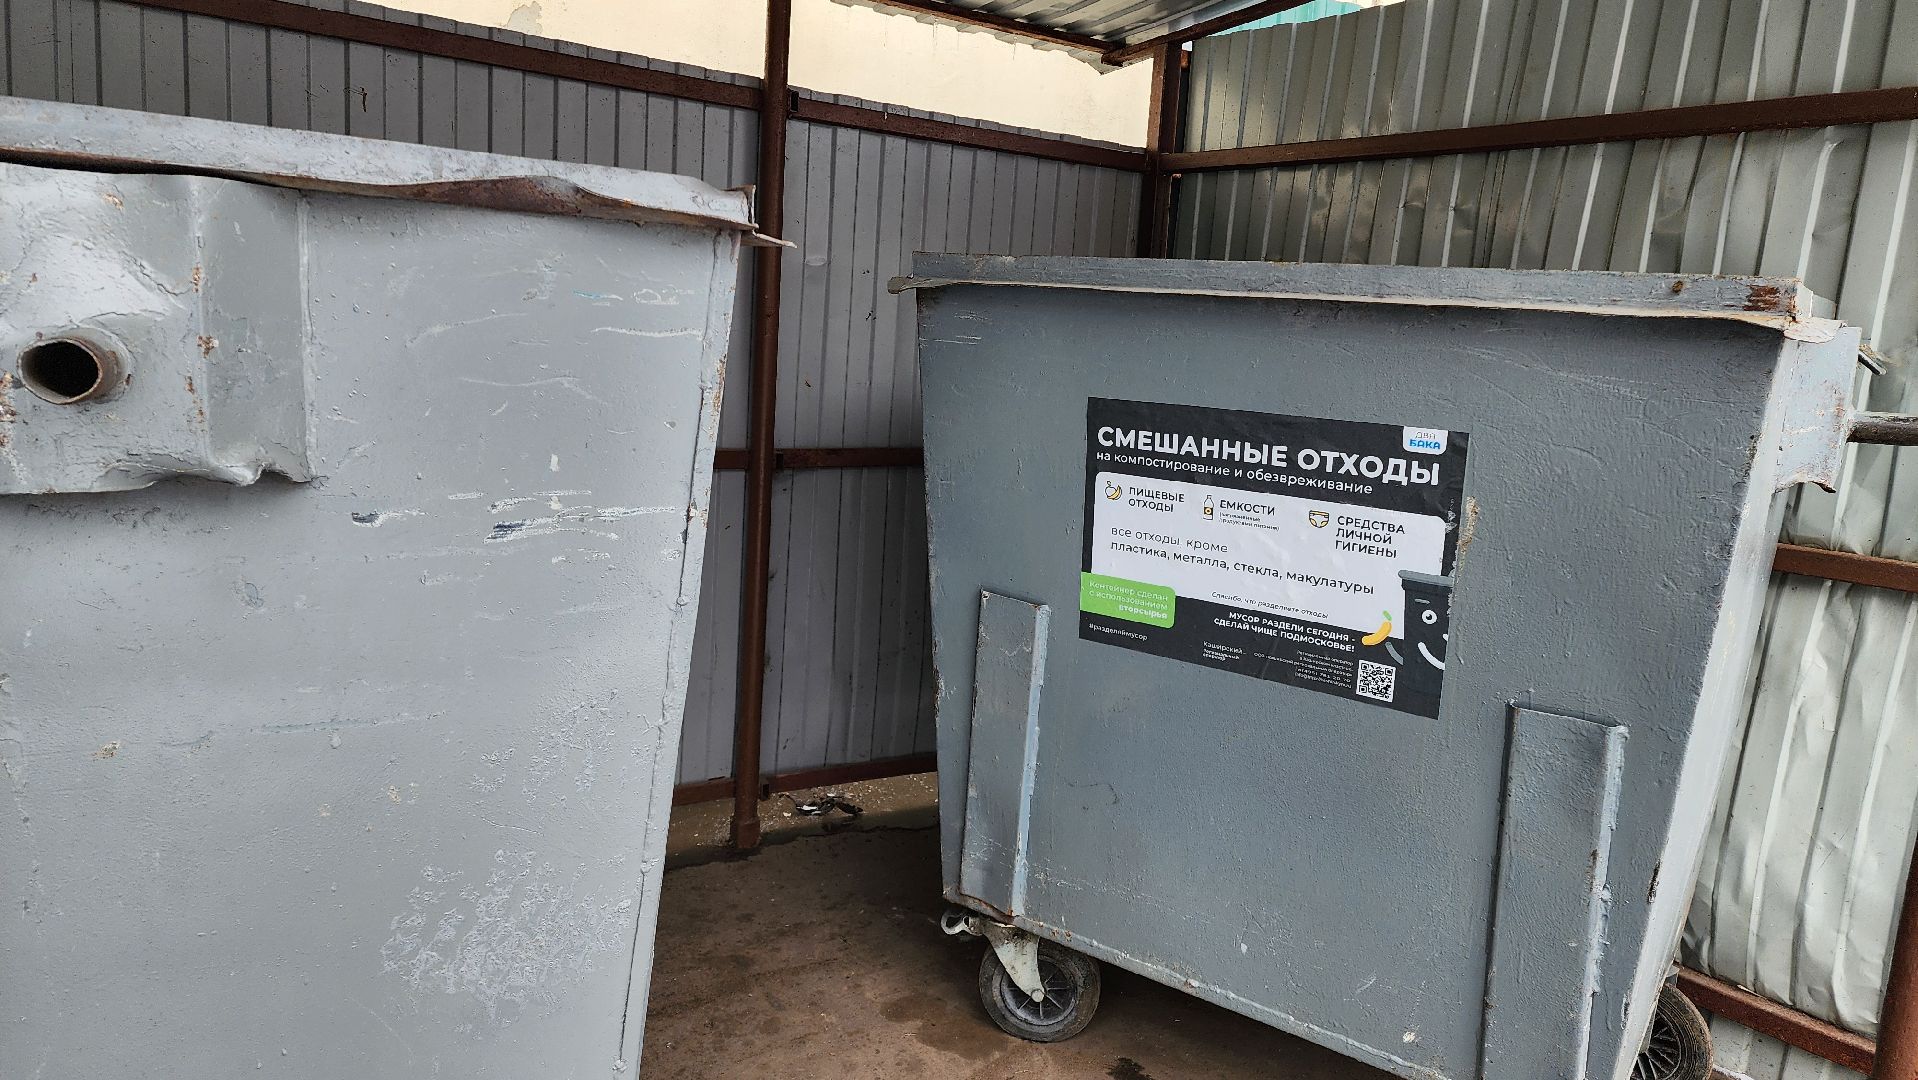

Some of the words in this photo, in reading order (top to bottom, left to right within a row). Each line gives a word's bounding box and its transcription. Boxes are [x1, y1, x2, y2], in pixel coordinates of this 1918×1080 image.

[1409, 438, 1441, 450] БАКА
[1097, 426, 1288, 468] СМЕШАННЫЕ
[1297, 448, 1440, 487] ОТХОДЫ
[1096, 451, 1111, 462] на
[1114, 453, 1230, 476] компостирование
[1234, 469, 1243, 478] и
[1246, 469, 1373, 494] обезвреживание
[1129, 486, 1185, 503] ПИЩЕВЫЕ
[1128, 498, 1174, 513] ОТХОДЫ
[1219, 499, 1275, 516] ЕМКОСТИ
[1337, 515, 1405, 535] СРЕДСТВА
[1111, 527, 1132, 538] все
[1186, 539, 1228, 553] кроме
[1335, 527, 1392, 545] ЛИЧНОЙ
[1335, 540, 1397, 559] ГИГИЕНЫ
[1111, 541, 1170, 560] пластика,
[1173, 552, 1230, 571] металла,
[1233, 561, 1282, 580] стекла,
[1286, 571, 1375, 595] макулатуры
[1089, 581, 1135, 596] Контейнер
[1136, 590, 1168, 602] сделан
[1096, 591, 1168, 611] использованием
[1119, 604, 1168, 620] вторсырья
[1244, 597, 1257, 606] что
[1301, 608, 1330, 620] отходы
[1088, 622, 1149, 642] #разделяймусор
[1213, 617, 1250, 631] СДЕЛАЙ
[1251, 624, 1278, 637] ЧИЩЕ
[1280, 630, 1356, 653] ПОДМОСКОВЬЕ!
[1228, 611, 1260, 624] МУСОР
[1262, 618, 1304, 633] РАЗДЕЛИ
[1306, 627, 1350, 643] СЕГОДНЯ
